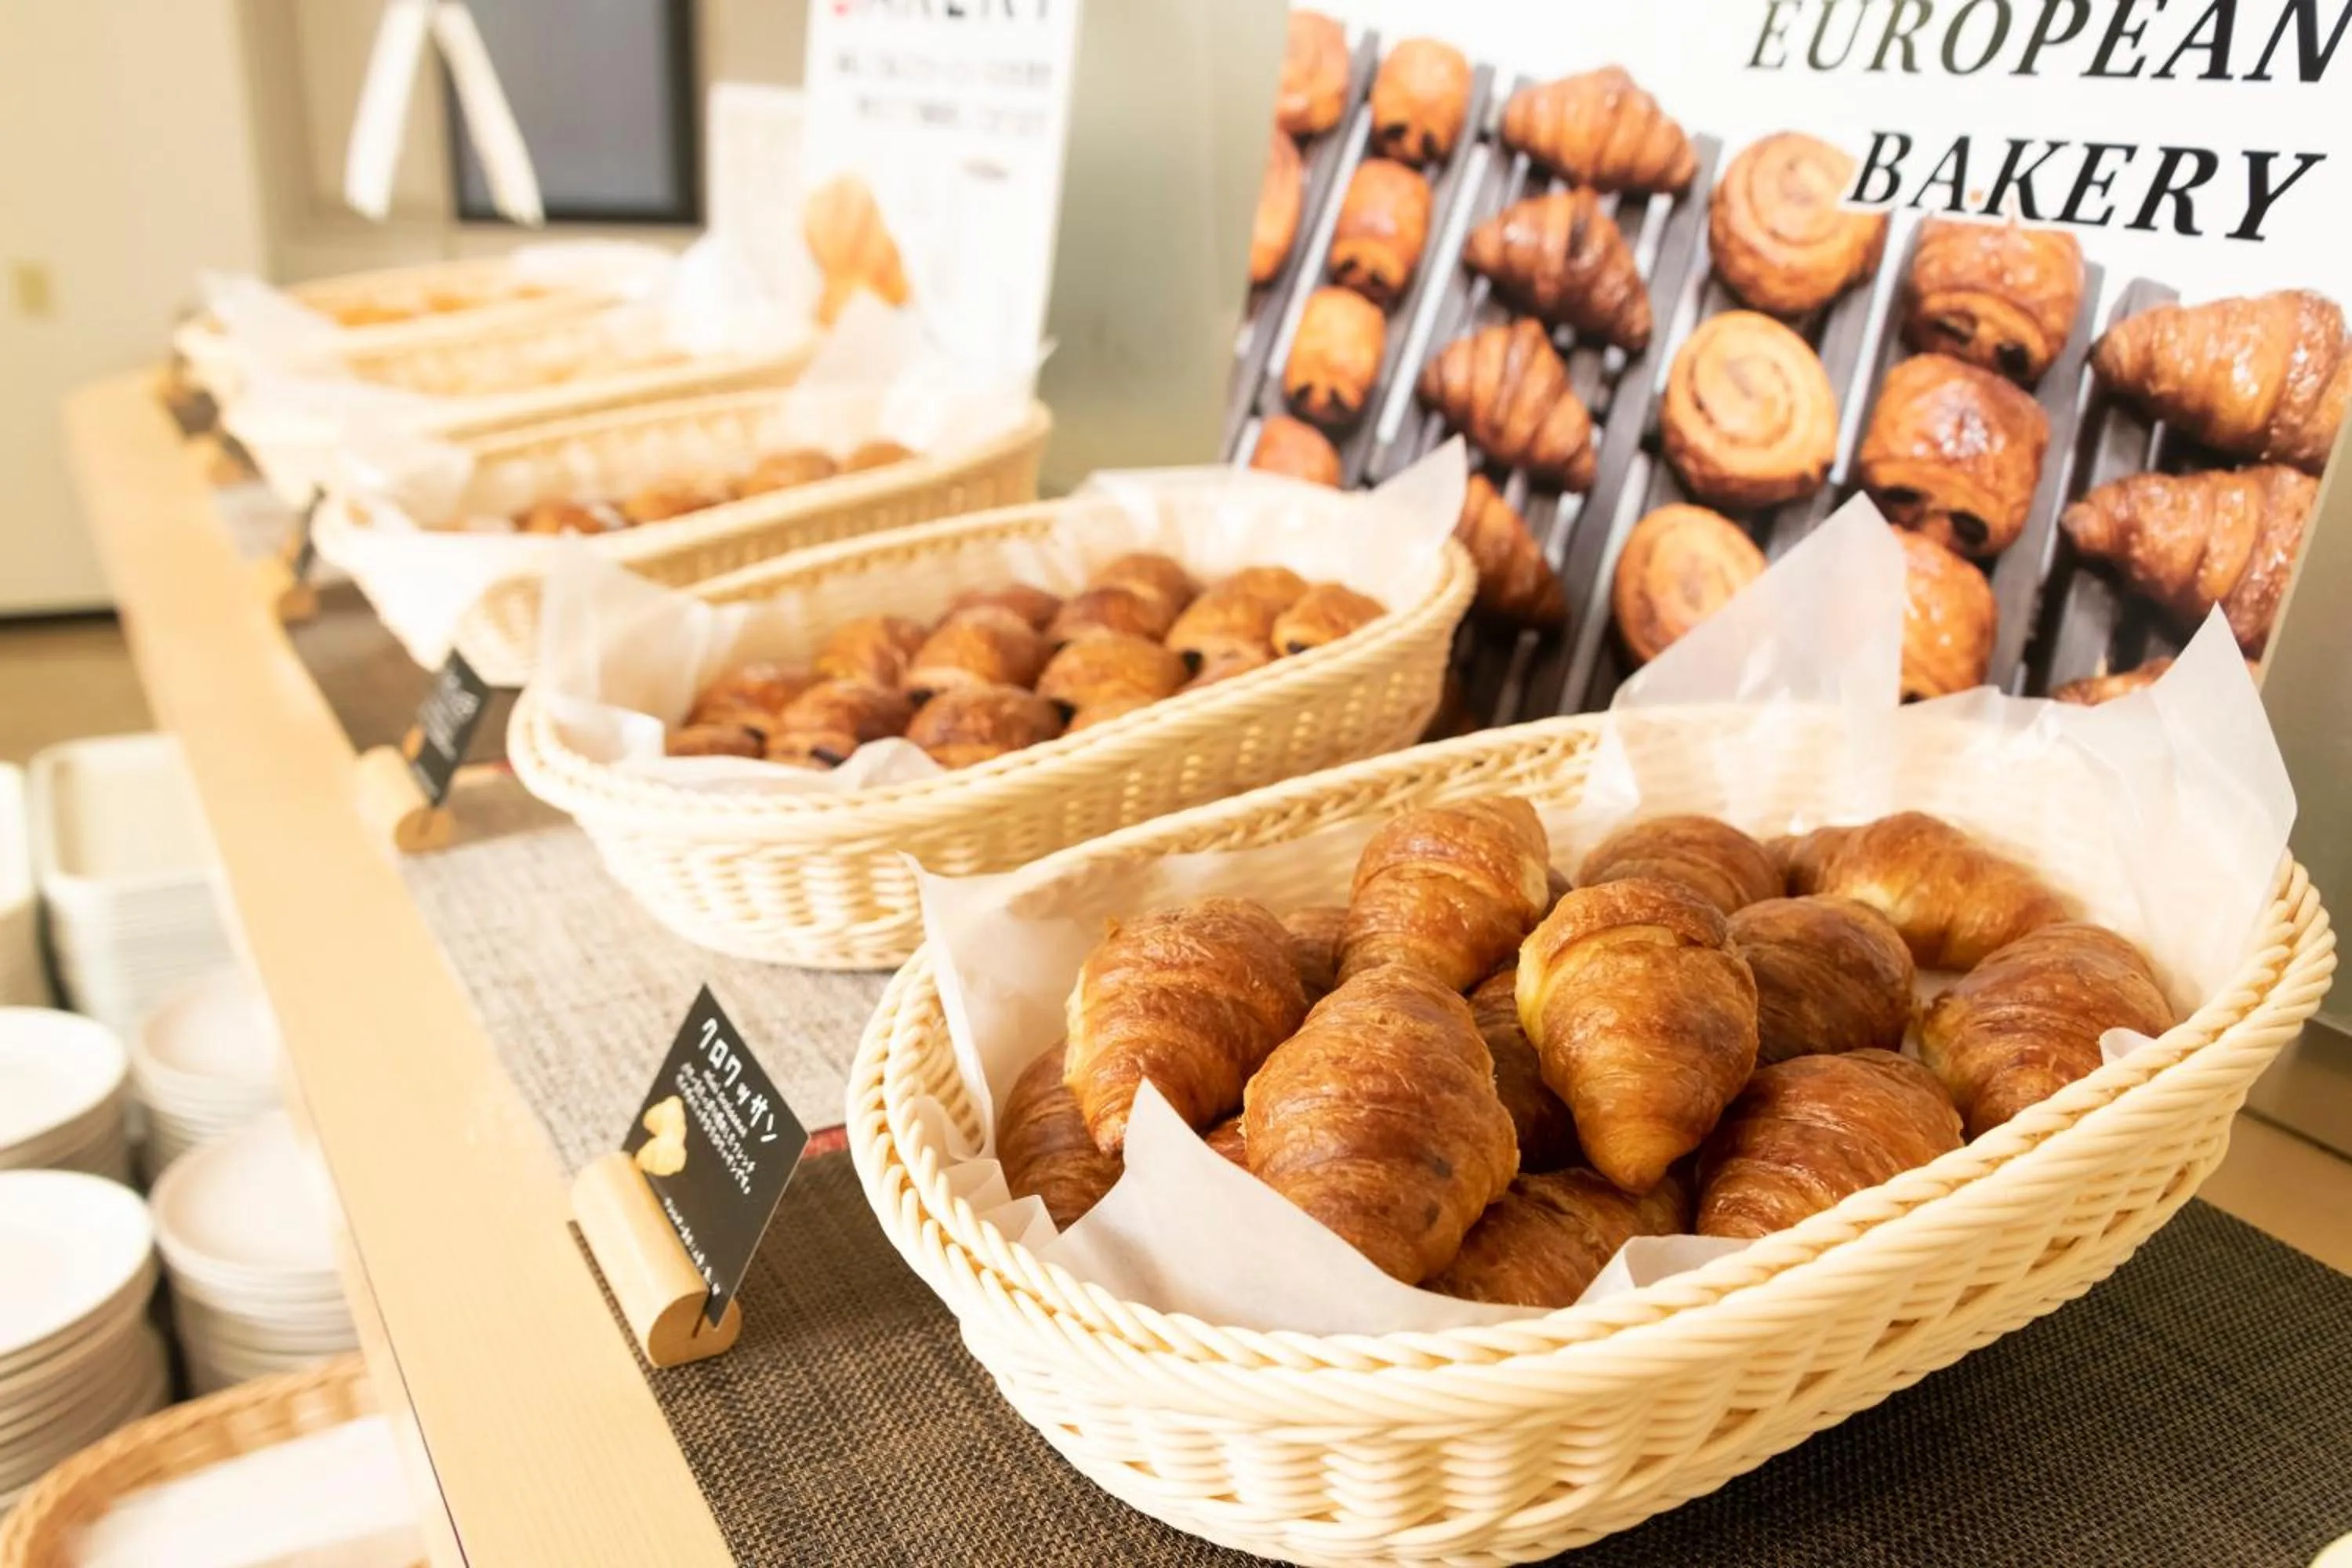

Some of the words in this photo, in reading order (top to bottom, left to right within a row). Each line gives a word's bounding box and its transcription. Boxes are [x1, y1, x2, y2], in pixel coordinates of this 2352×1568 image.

[1748, 0, 2352, 82] EUROPEAN
[1847, 130, 2327, 241] BAKERY
[699, 1018, 778, 1142] クロワッサン
